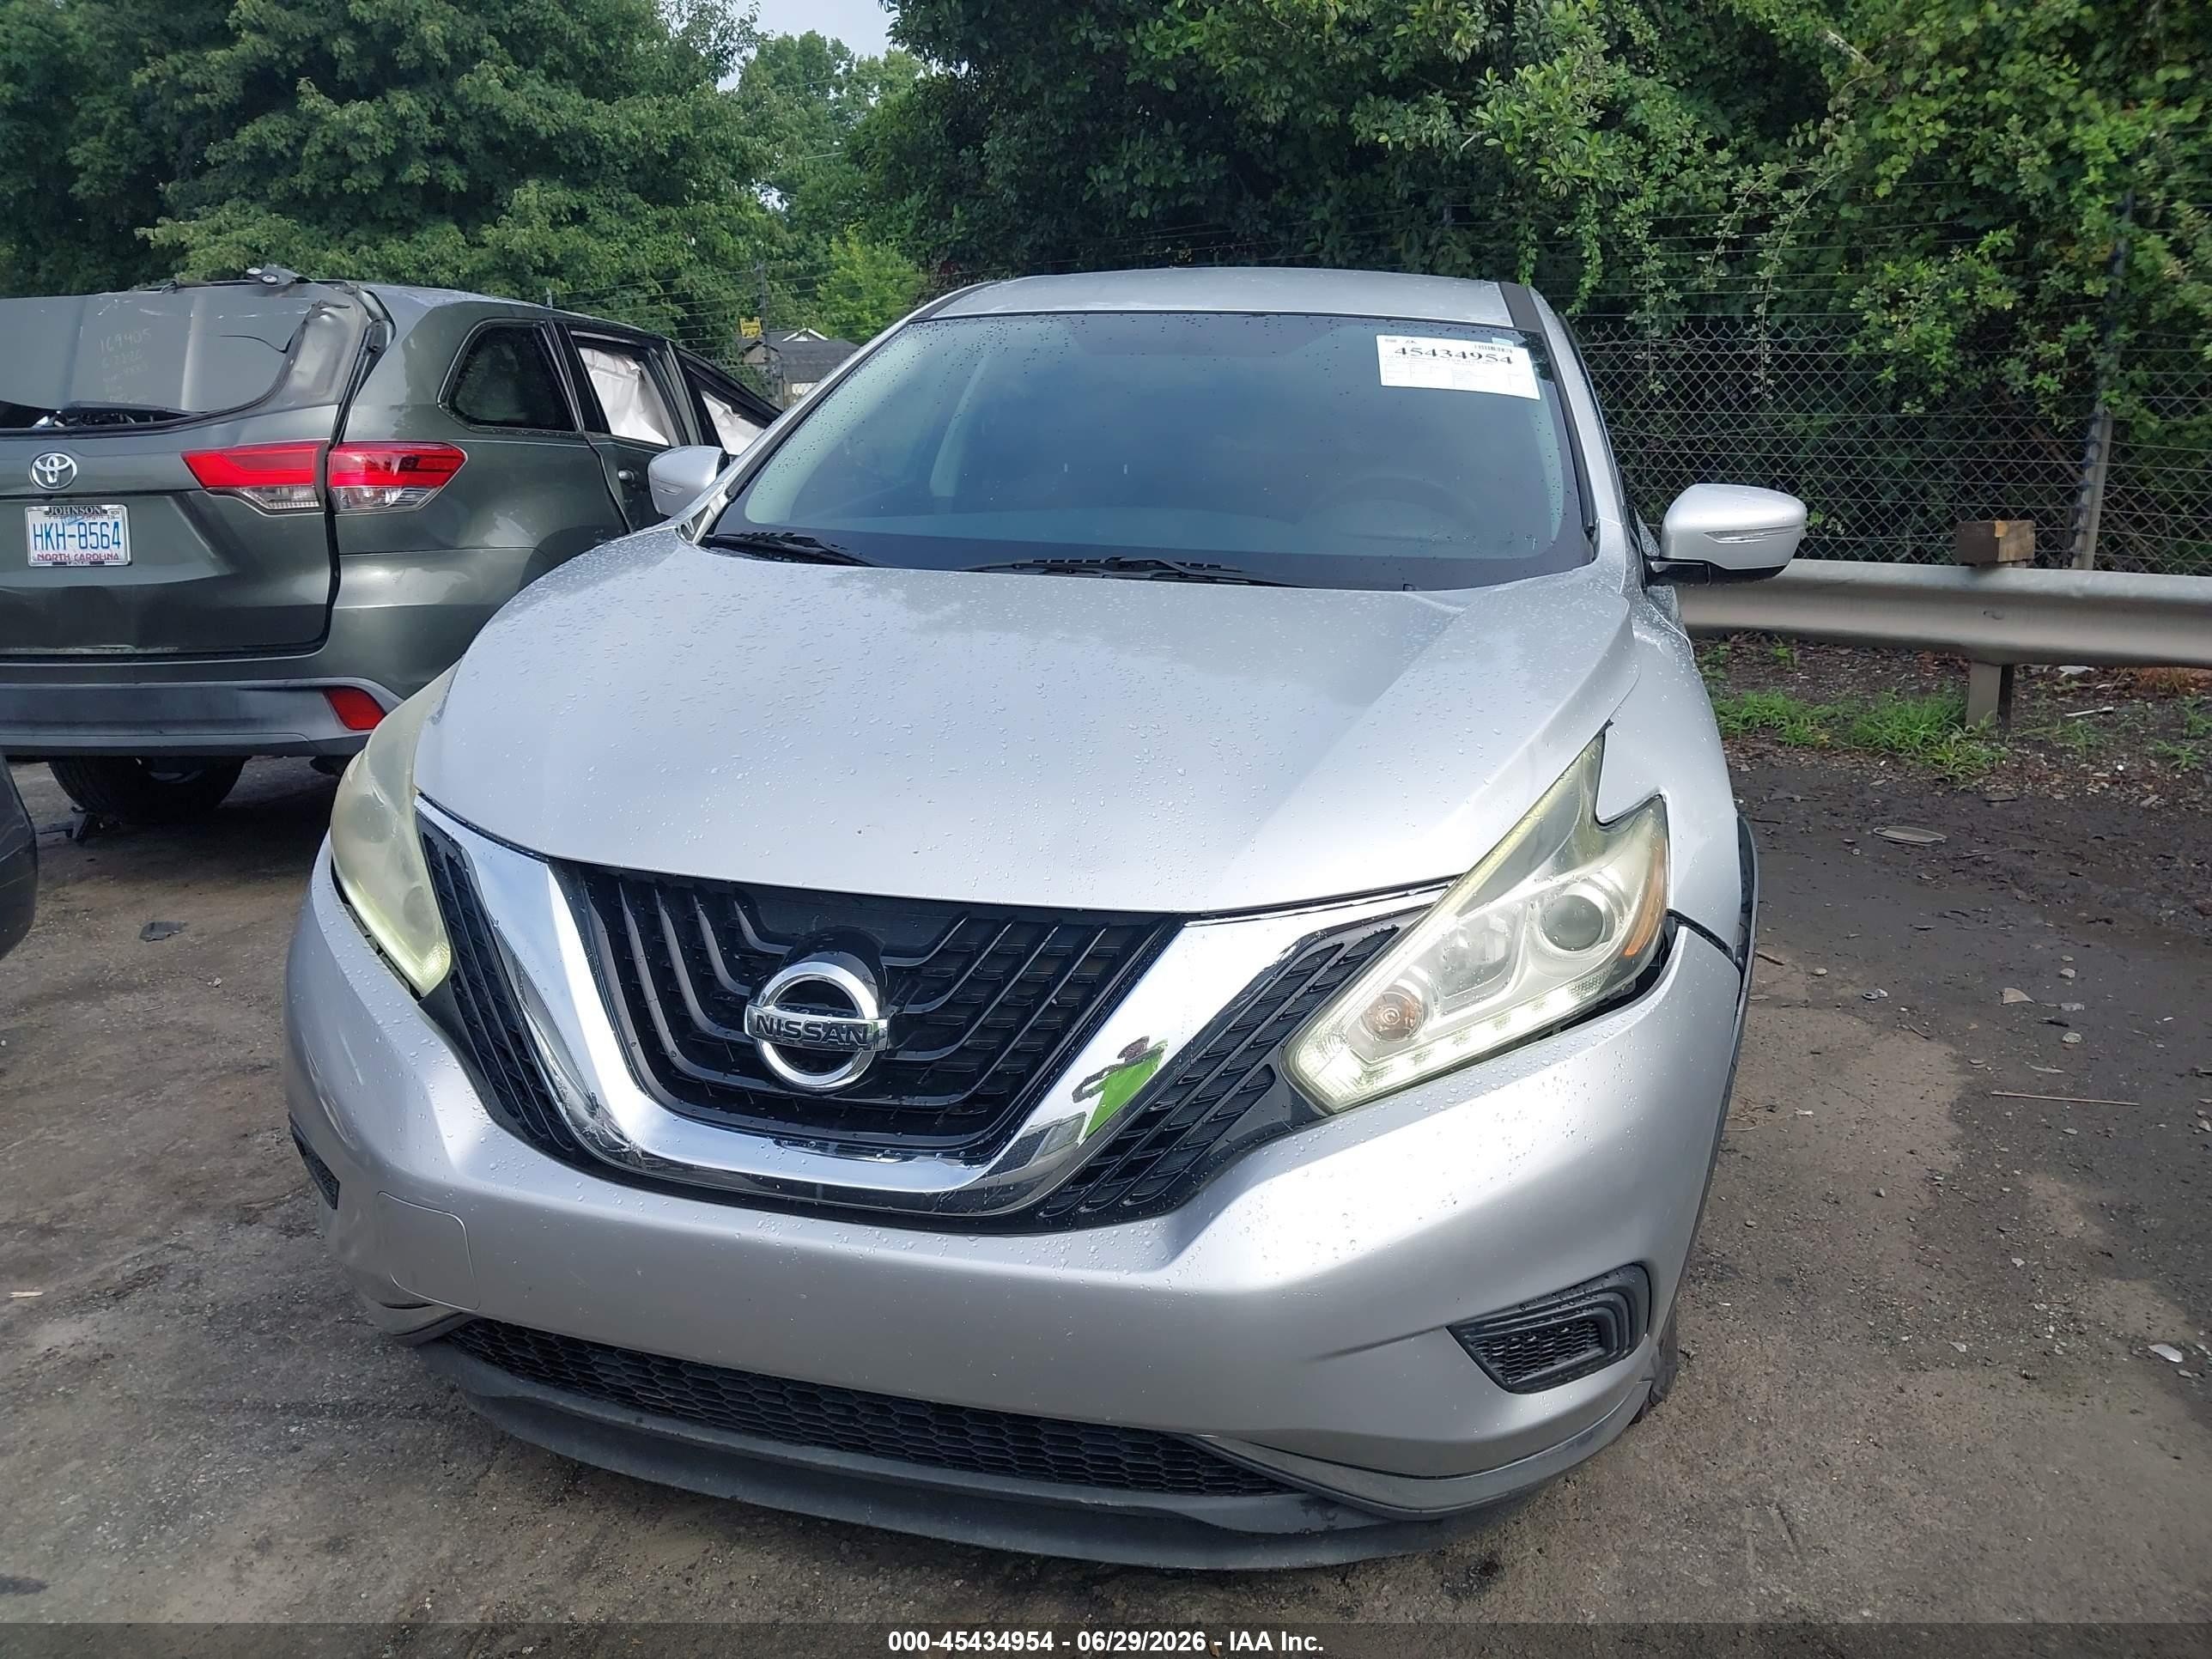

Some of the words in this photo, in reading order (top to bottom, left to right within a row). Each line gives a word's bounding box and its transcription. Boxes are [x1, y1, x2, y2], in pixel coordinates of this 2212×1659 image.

[1394, 347, 1513, 365] 45434954
[48, 506, 101, 515] JOHNSON
[33, 521, 121, 550] HKH-8564
[37, 553, 70, 562] NORTH
[74, 552, 119, 561] CAROLINA
[755, 1013, 869, 1046] NISSAN
